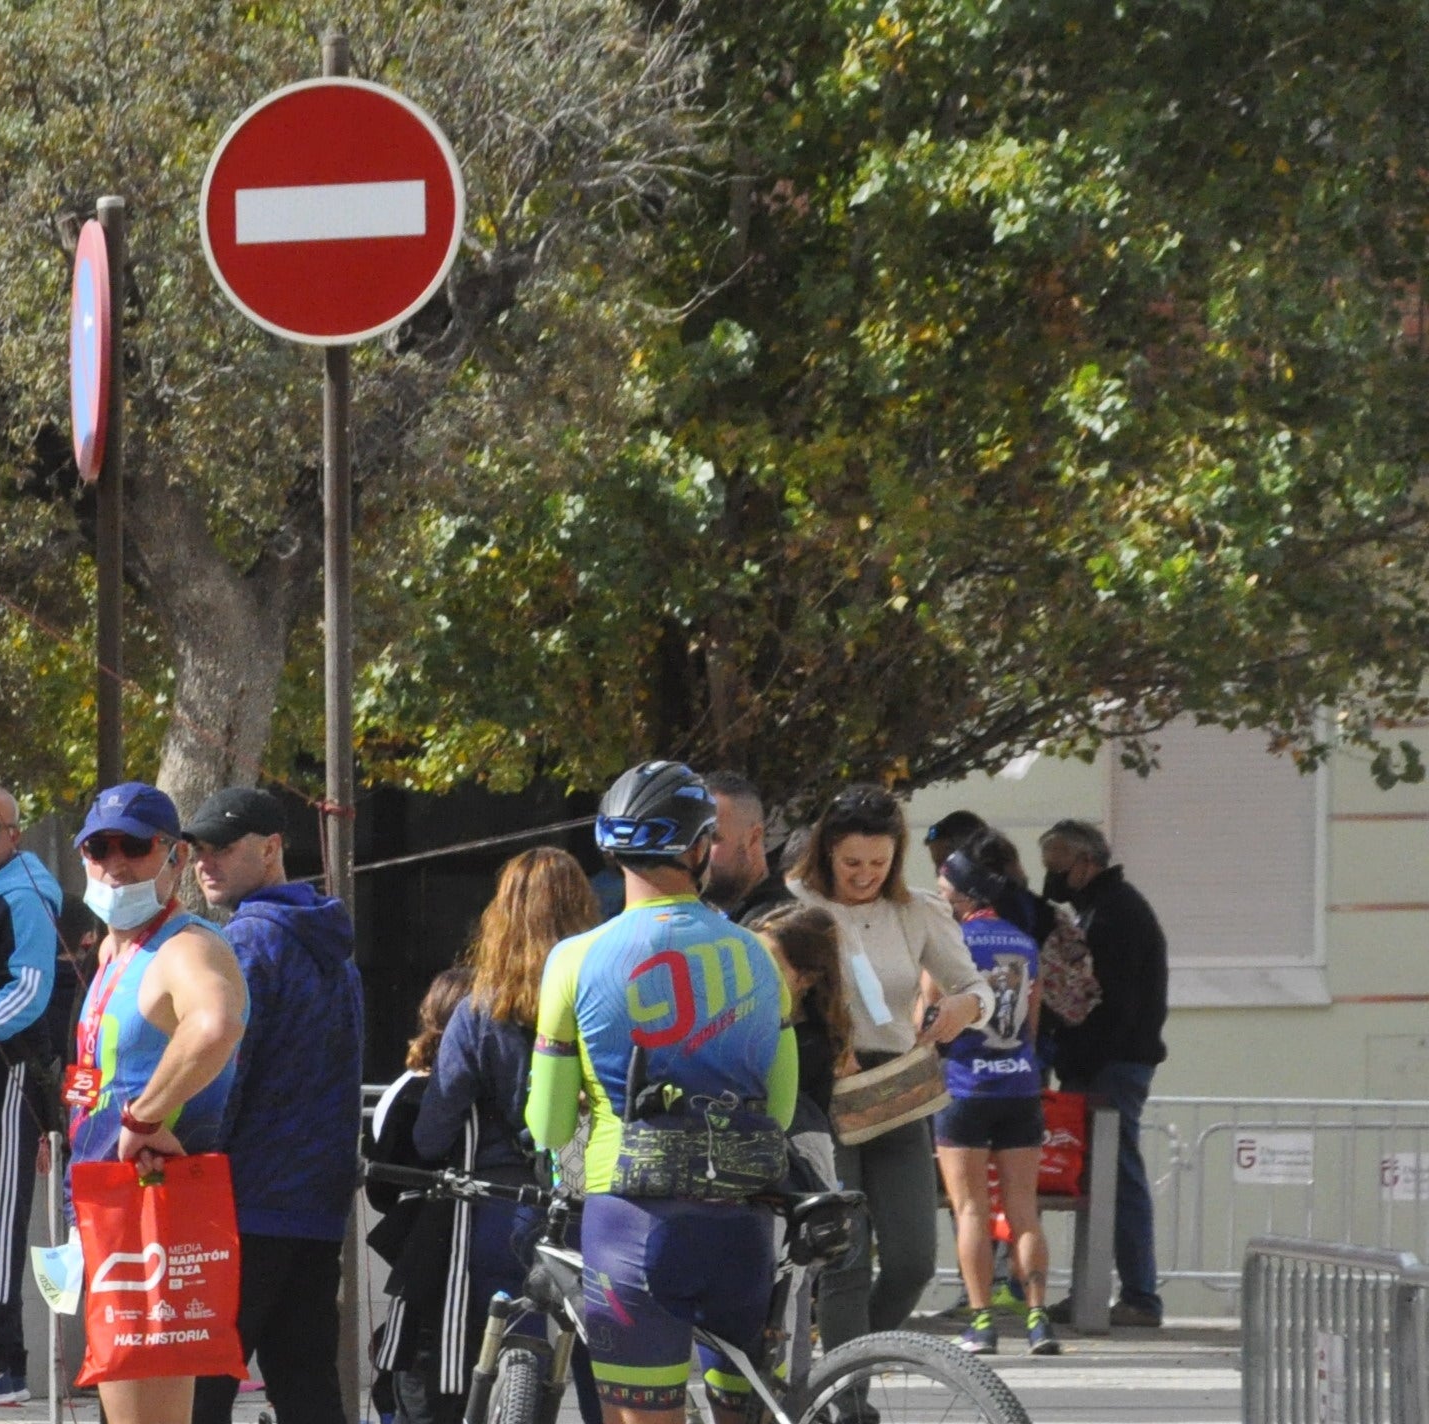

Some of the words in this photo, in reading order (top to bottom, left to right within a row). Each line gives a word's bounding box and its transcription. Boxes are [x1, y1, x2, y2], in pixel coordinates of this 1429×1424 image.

[168, 1243, 204, 1255] MEDIA
[168, 1250, 230, 1266] MARATÓN
[168, 1264, 202, 1276] BAZA
[114, 1333, 143, 1347] HAZ
[144, 1328, 210, 1345] HISTORIA
